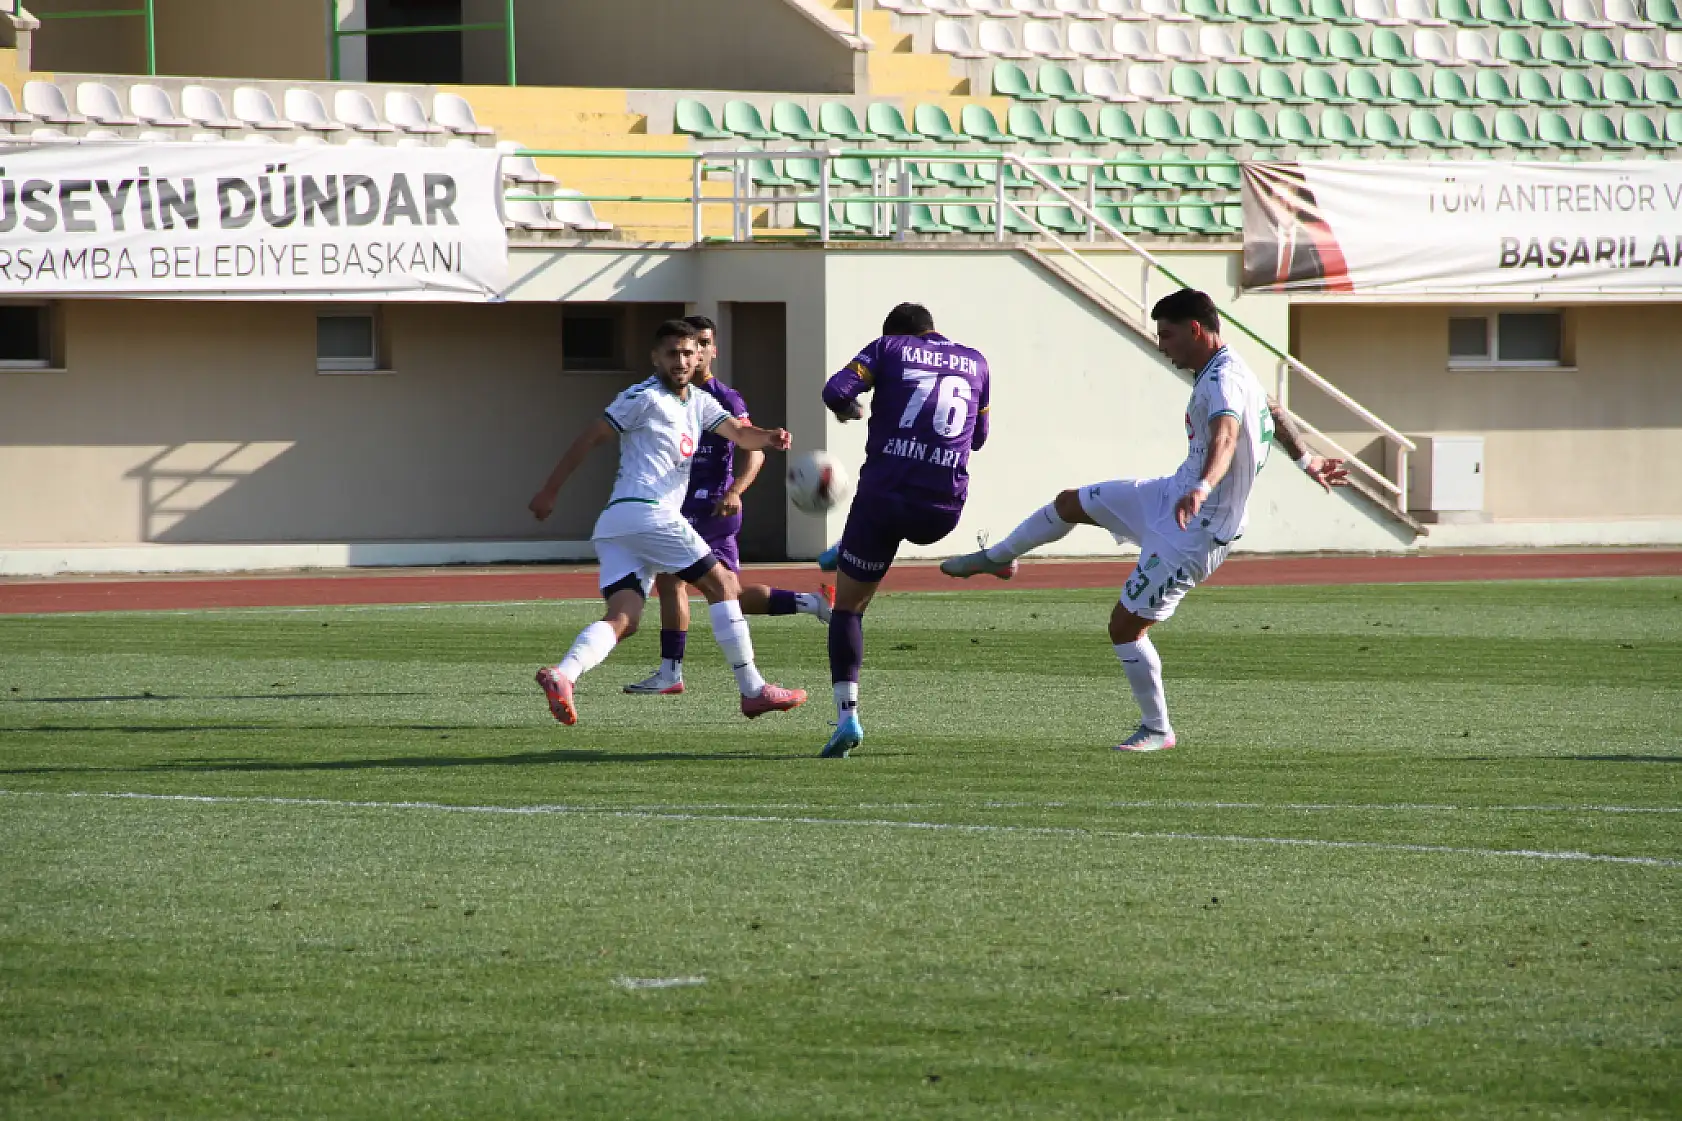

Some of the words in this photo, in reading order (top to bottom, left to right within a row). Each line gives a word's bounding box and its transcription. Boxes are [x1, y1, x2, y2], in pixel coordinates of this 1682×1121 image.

[217, 163, 460, 230] DÜNDAR
[1428, 177, 1486, 213] TÜM
[1496, 176, 1656, 212] ANTRENÖR
[151, 239, 309, 279] BELEDİYE
[321, 241, 462, 278] BAŞKANI
[901, 346, 977, 376] KARE-PEN
[898, 367, 972, 437] 76
[883, 436, 928, 461] EMİN
[928, 447, 961, 468] ARI
